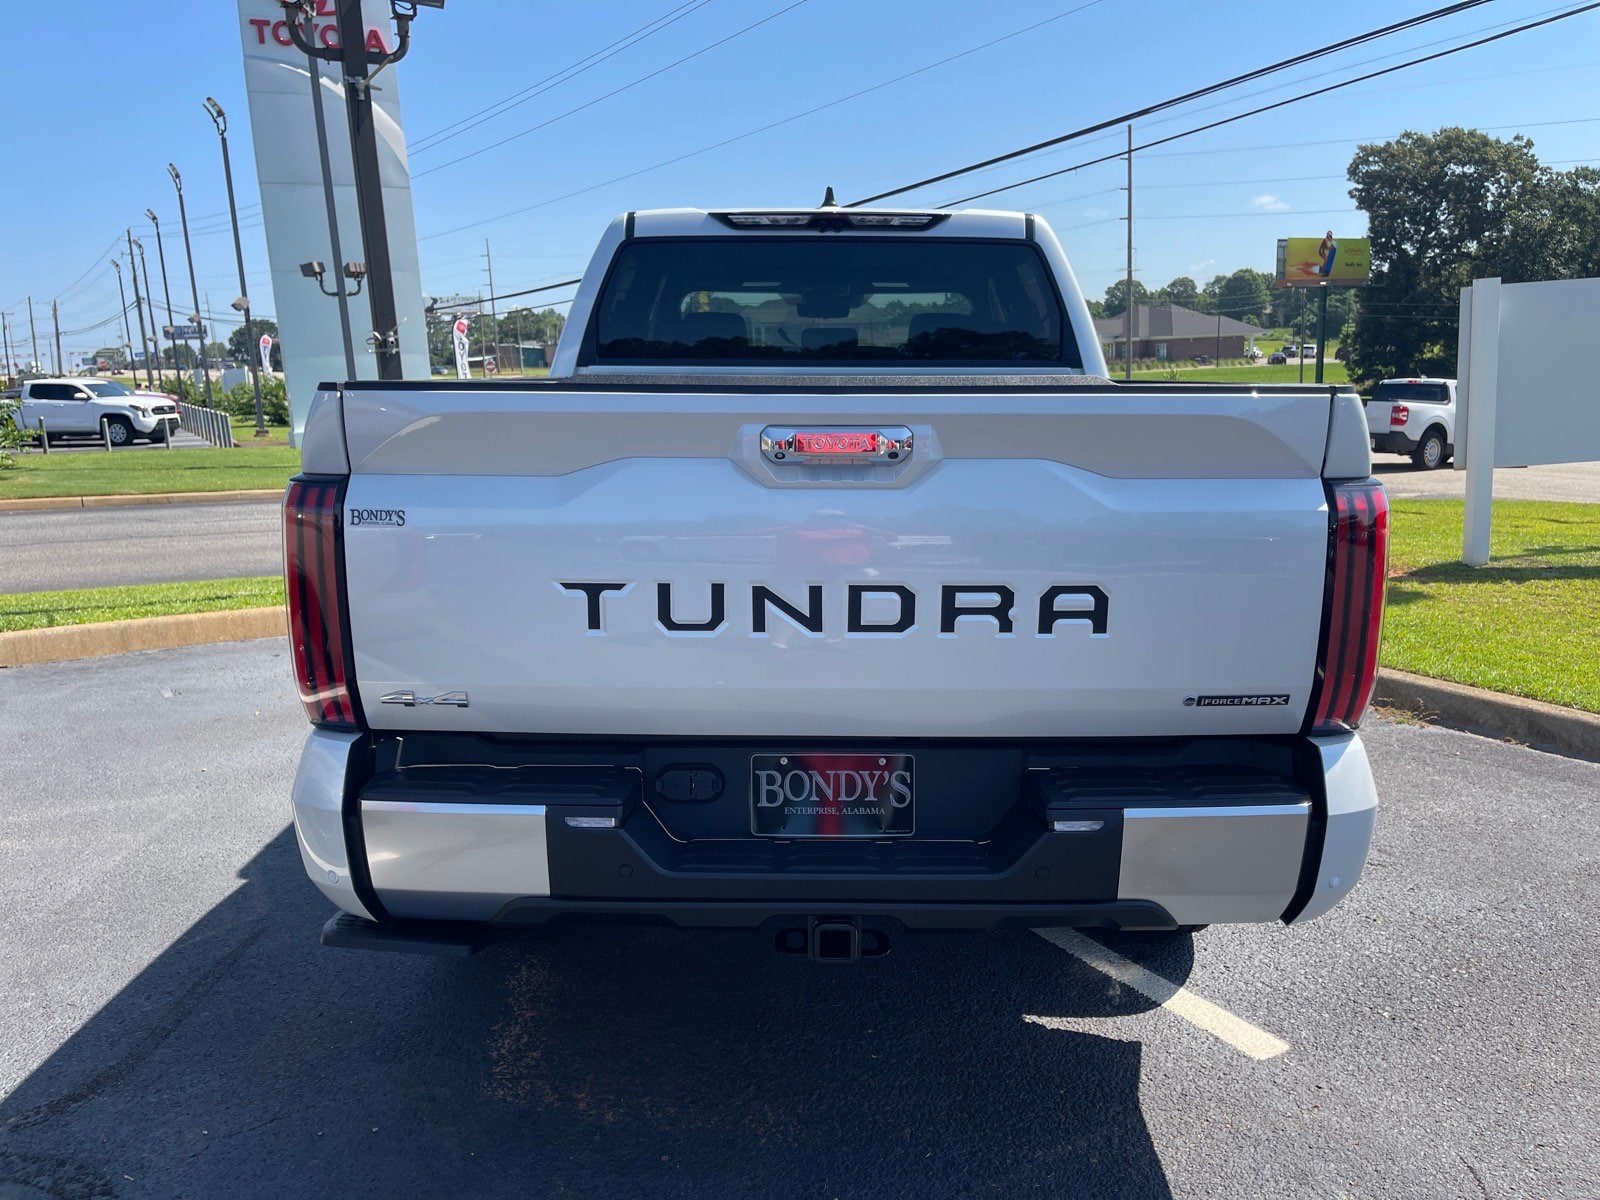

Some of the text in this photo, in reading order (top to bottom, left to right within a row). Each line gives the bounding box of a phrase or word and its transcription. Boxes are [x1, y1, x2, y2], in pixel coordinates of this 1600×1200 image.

[249, 18, 388, 55] TOOA
[802, 437, 871, 450] TOYOTA
[350, 508, 406, 527] BONDY'S
[554, 581, 1111, 638] TUNDRA
[755, 769, 911, 808] BONDY'S
[784, 807, 885, 816] ENTERPRISE, ALABAMA
